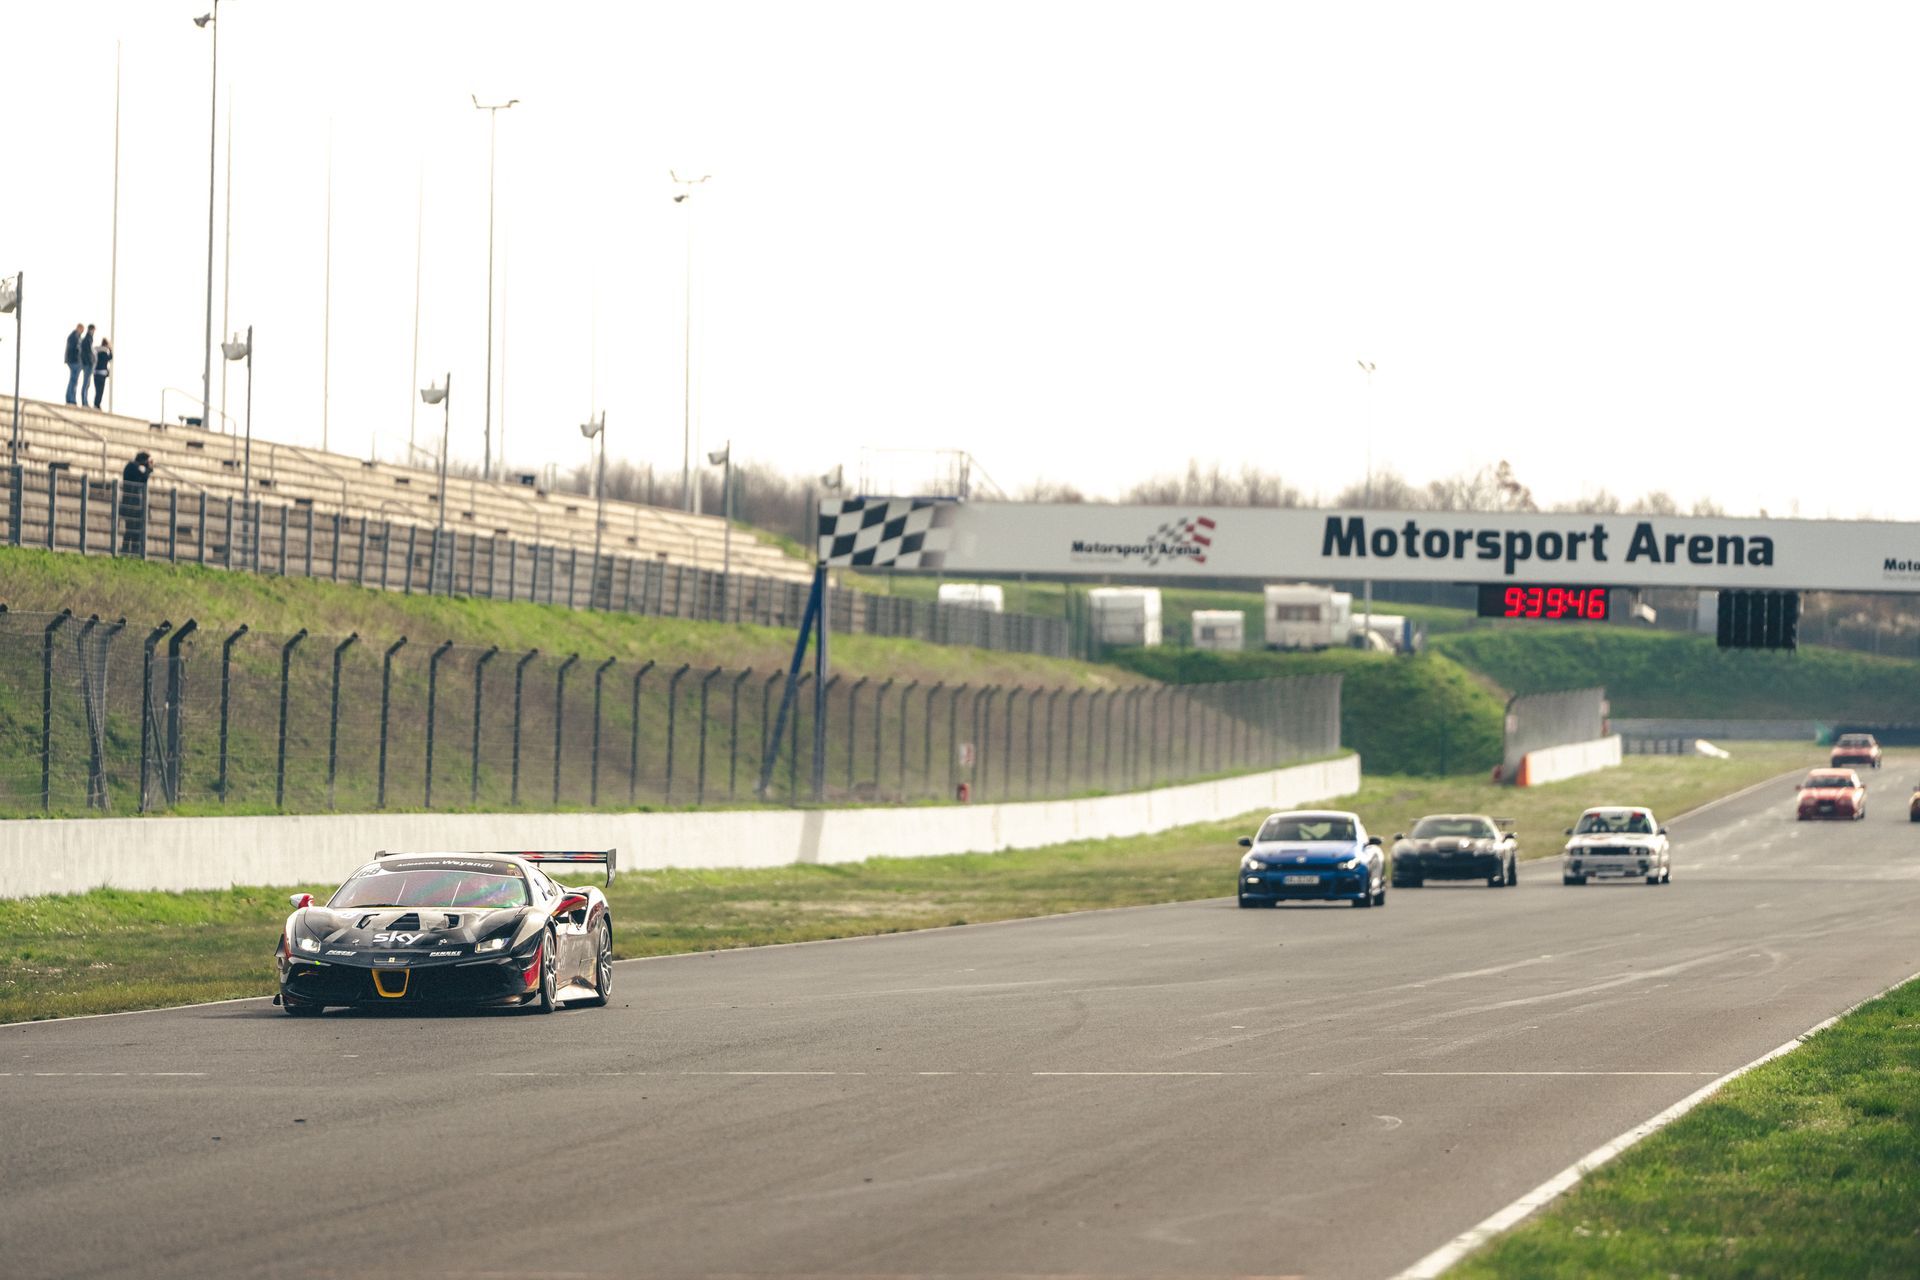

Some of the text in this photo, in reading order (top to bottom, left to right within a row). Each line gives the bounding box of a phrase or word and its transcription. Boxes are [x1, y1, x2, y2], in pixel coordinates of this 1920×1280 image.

[1071, 540, 1202, 559] Motorsport Arena
[1321, 516, 1775, 575] Motorsport Arena
[1504, 587, 1606, 619] 9:39:46
[372, 931, 425, 945] sky
